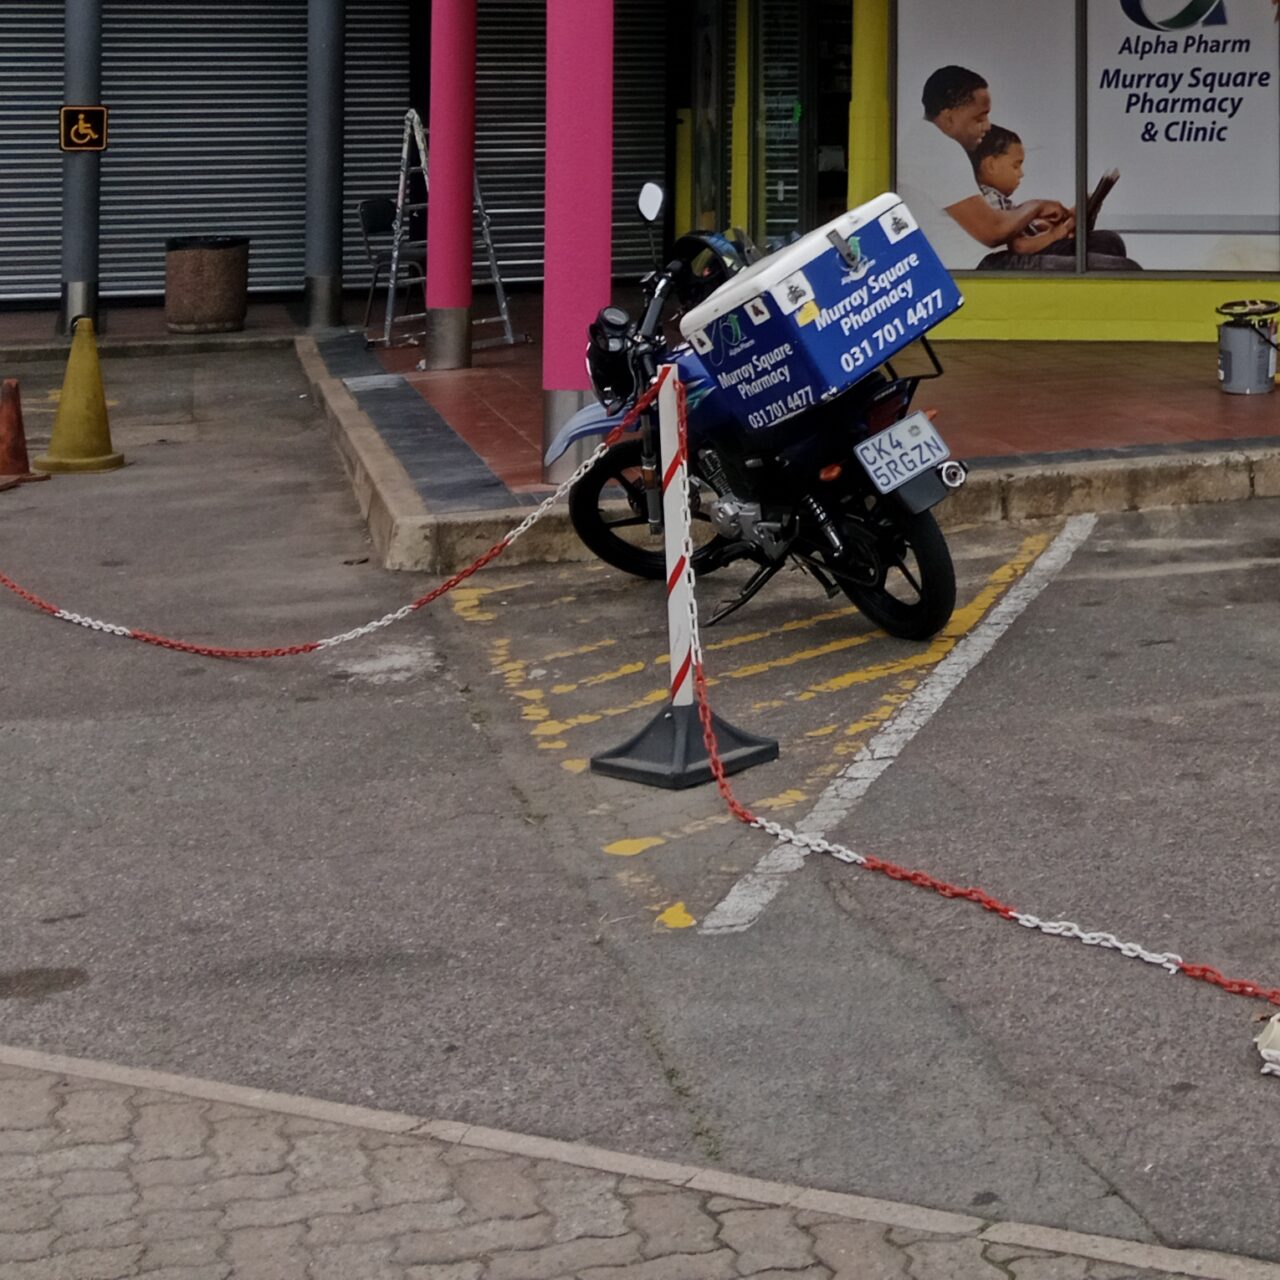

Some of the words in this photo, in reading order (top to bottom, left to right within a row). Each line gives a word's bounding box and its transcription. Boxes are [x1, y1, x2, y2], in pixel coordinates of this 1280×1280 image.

[1118, 34, 1178, 61] Alpha
[1183, 34, 1251, 54] Pharm
[1099, 68, 1185, 94] Murray
[1187, 67, 1271, 94] Square
[1125, 92, 1244, 119] Pharmacy
[1141, 121, 1159, 142] &
[1164, 120, 1228, 142] Clinic
[814, 286, 869, 331] Murray
[867, 253, 920, 294] Square
[840, 279, 913, 336] Pharmacy
[840, 339, 873, 373] 031
[872, 318, 905, 351] 701
[906, 288, 943, 326] 4477
[717, 362, 756, 389] Murray
[752, 342, 794, 371] Square
[737, 365, 791, 399] Pharmacy
[748, 409, 769, 429] 031
[766, 399, 788, 420] 701
[787, 385, 816, 410] 4477
